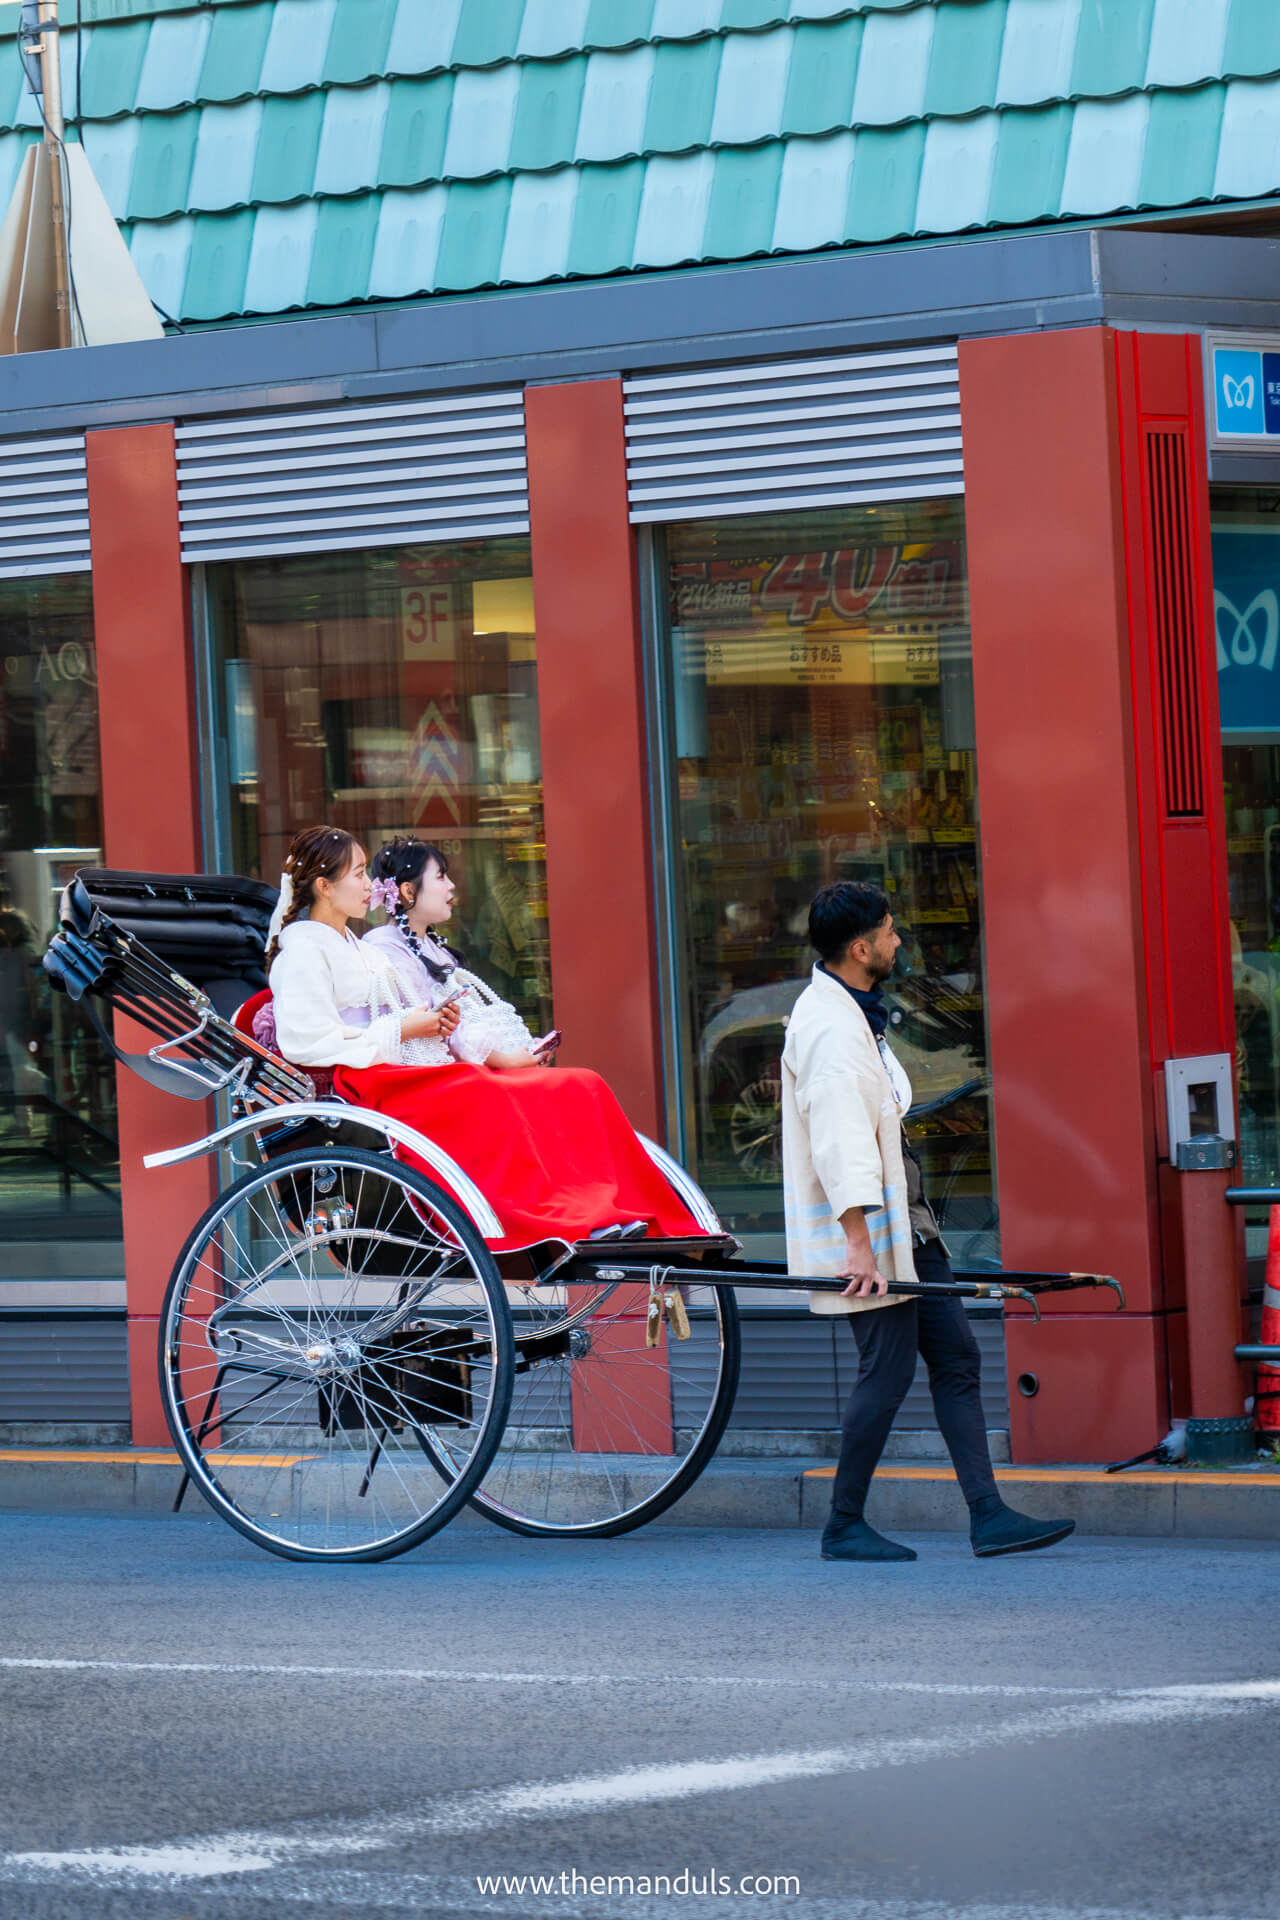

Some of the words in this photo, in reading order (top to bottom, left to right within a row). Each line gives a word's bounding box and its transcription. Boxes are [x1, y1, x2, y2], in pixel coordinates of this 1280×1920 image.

[406, 591, 450, 644] 3F
[789, 644, 842, 664] おすすめ品
